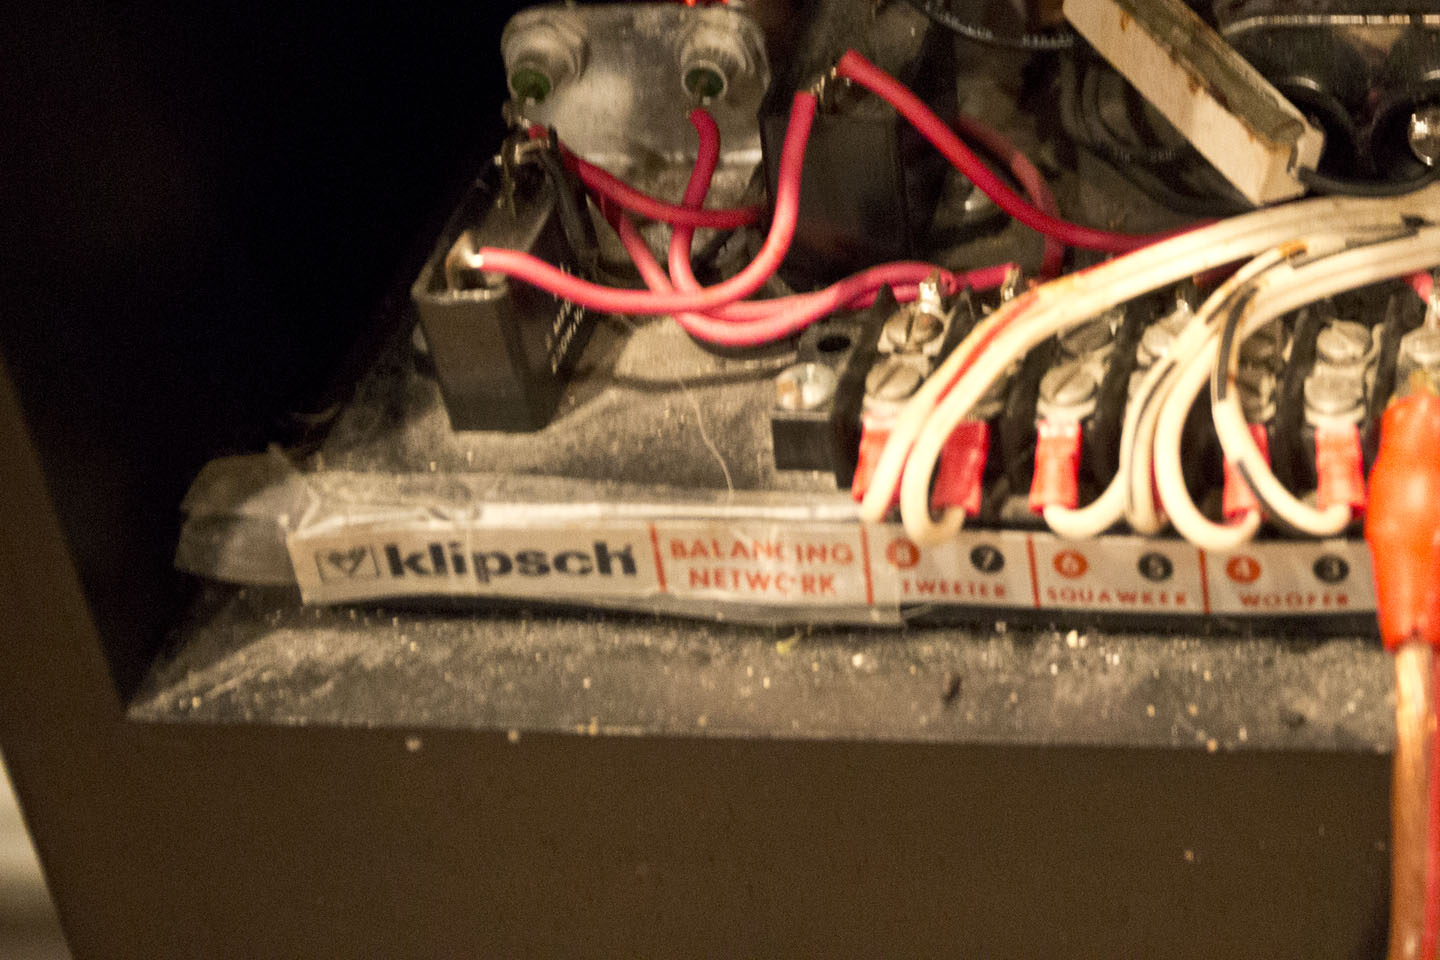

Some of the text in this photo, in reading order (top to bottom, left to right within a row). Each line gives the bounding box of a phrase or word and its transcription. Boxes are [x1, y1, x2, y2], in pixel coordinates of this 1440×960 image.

[384, 542, 637, 584] klipsch
[669, 539, 854, 565] BALANCING
[688, 568, 837, 596] NETWORK
[903, 579, 1005, 598] TWEETER
[1240, 592, 1348, 608] WOOFER
